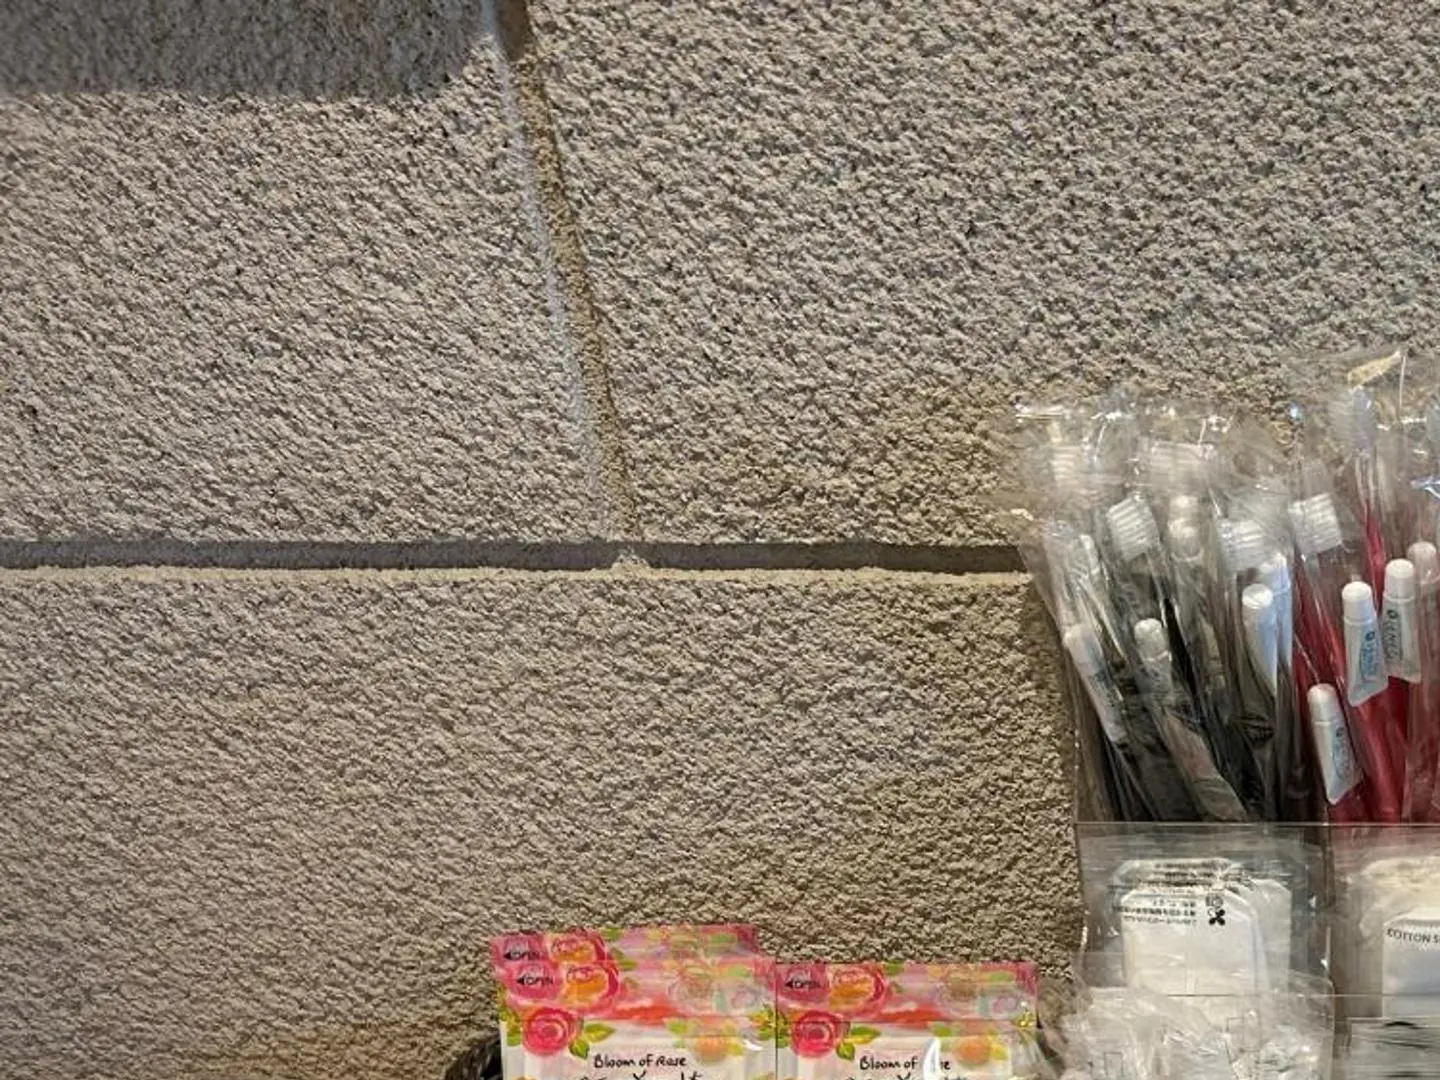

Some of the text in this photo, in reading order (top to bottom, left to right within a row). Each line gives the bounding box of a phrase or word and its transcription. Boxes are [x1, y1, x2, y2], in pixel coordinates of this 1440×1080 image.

[1387, 928, 1431, 943] COTTON
[594, 1054, 687, 1069] Bloom of Rose
[860, 1057, 901, 1071] Bloom
[903, 1056, 919, 1070] of
